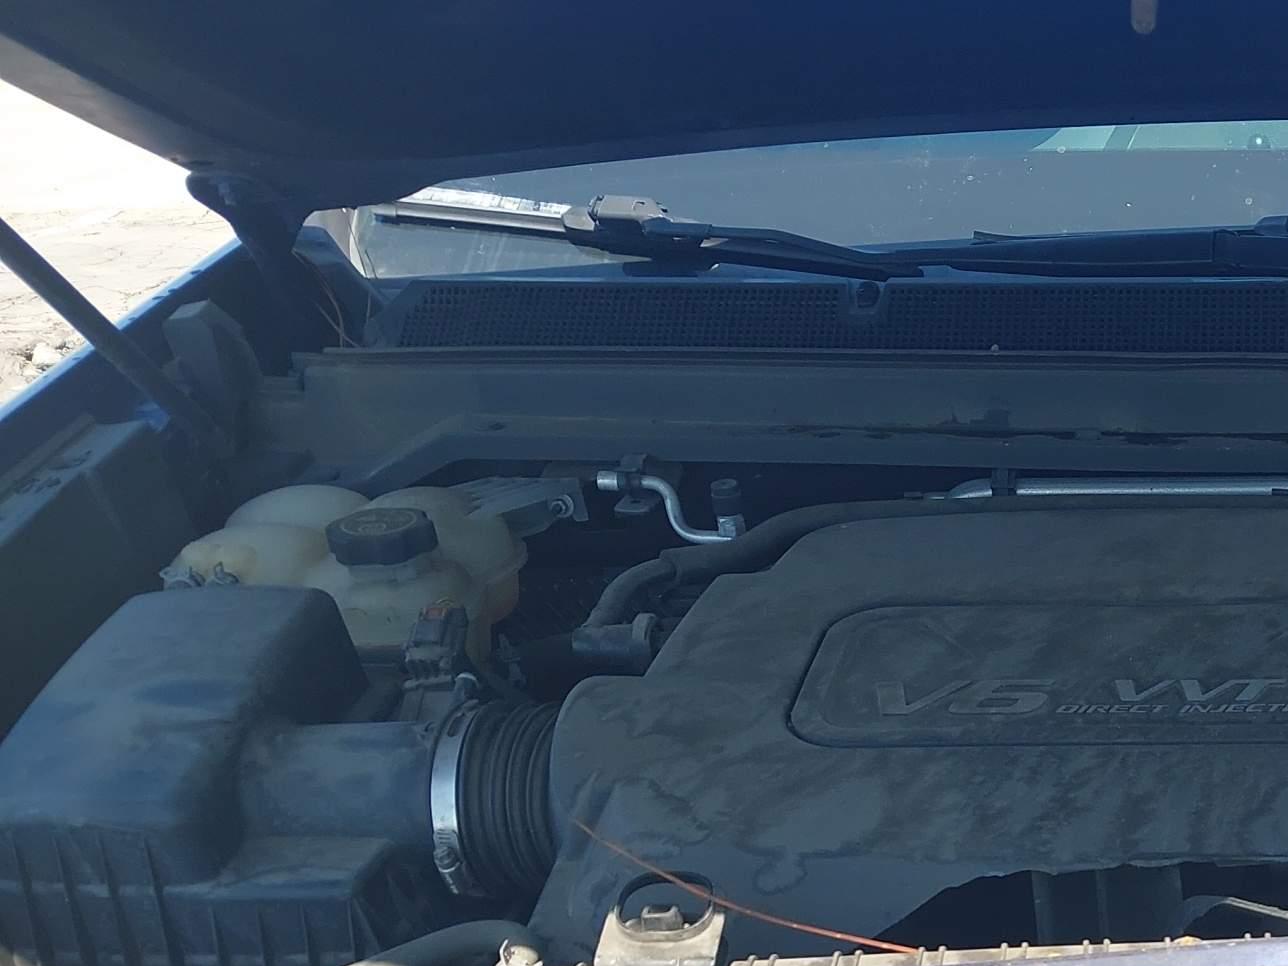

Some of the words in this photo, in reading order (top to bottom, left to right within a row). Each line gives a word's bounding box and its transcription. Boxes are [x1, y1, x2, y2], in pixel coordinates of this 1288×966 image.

[876, 679, 1056, 716] V6
[1115, 679, 1287, 701] VVT
[1055, 703, 1170, 714] DIRECT
